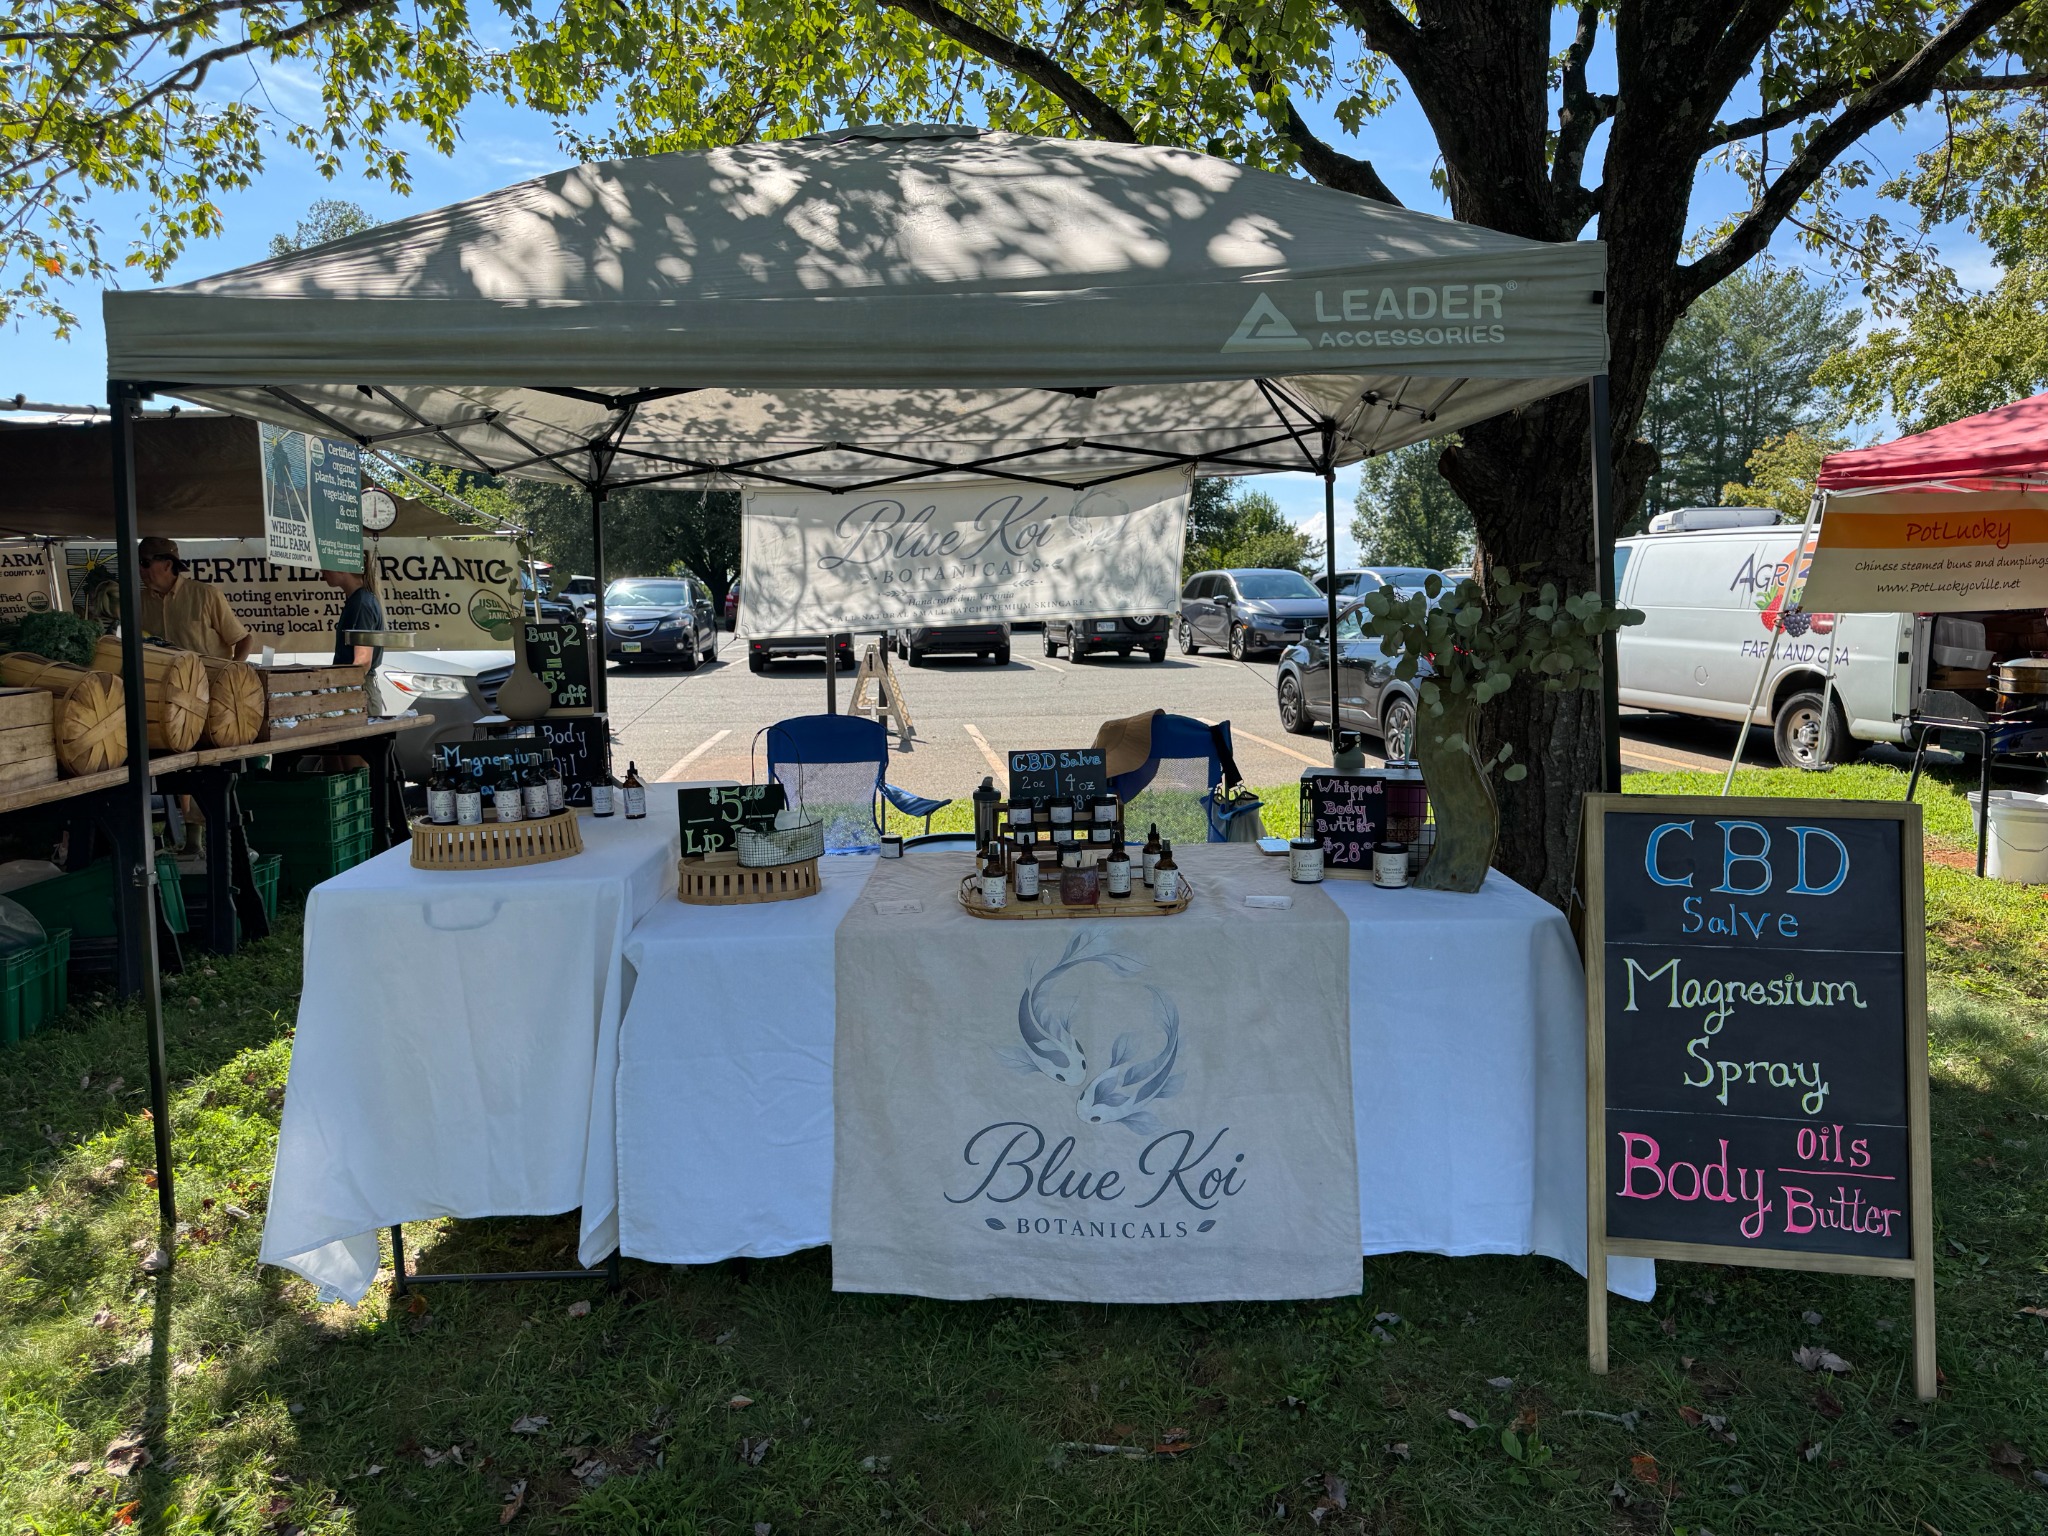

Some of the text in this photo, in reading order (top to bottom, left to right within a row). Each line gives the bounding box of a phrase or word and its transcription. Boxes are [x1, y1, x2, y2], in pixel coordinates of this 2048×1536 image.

[1319, 325, 1506, 348] ACCESSORIES
[328, 443, 356, 460] Certified
[332, 461, 357, 475] organic
[315, 471, 358, 490] plants, herbs,
[323, 488, 358, 504] vegetables,
[339, 504, 358, 518] & cut
[271, 520, 308, 537] WHISPER
[335, 518, 360, 533] flowers
[817, 495, 1057, 571] Blue Koi
[1906, 517, 2011, 549] PotLucky
[270, 534, 311, 552] HILL FARM
[1, 553, 44, 567] ARM
[377, 556, 507, 584] RGANIC
[883, 558, 1042, 584] BOTANICALS
[1855, 554, 2048, 571] Chinese steamed buns and dumplings
[3, 569, 35, 577] COUNTY,
[224, 590, 271, 604] moting
[392, 588, 440, 601] health
[1877, 578, 2021, 596] www.PotLuckycville.net
[861, 611, 909, 621] NATURAL
[913, 609, 946, 617] SMALL
[950, 606, 982, 615] BATCH
[986, 602, 1031, 612] PREMIUM
[1034, 599, 1085, 609] SKINCARE
[908, 594, 963, 607] Handcrafted
[979, 591, 1015, 603] Virginia
[231, 604, 310, 618] ccountable
[385, 603, 461, 617] non-GMO
[288, 619, 324, 632] local
[386, 620, 430, 631] stems
[526, 624, 581, 655] Buy 2
[1783, 642, 1815, 662] AND
[558, 684, 587, 706] off
[542, 722, 587, 758] Body
[1012, 750, 1102, 772] CBD Salve
[1022, 776, 1031, 789] 2
[1065, 773, 1096, 792] 4 oz
[1316, 778, 1383, 800] Whipped
[1322, 801, 1367, 824] Body
[1316, 816, 1376, 833] Butter
[685, 828, 725, 854] Lip
[1645, 819, 1850, 896] CBD
[1682, 896, 1799, 940] Salve
[1623, 957, 1868, 1035] Magnesium
[1683, 1036, 1829, 1115] Spray
[943, 1121, 1247, 1211] Blue Koi
[1616, 1131, 1773, 1239] Body
[1780, 1185, 1902, 1238] Butter
[1016, 1217, 1189, 1240] BOTANICALS
